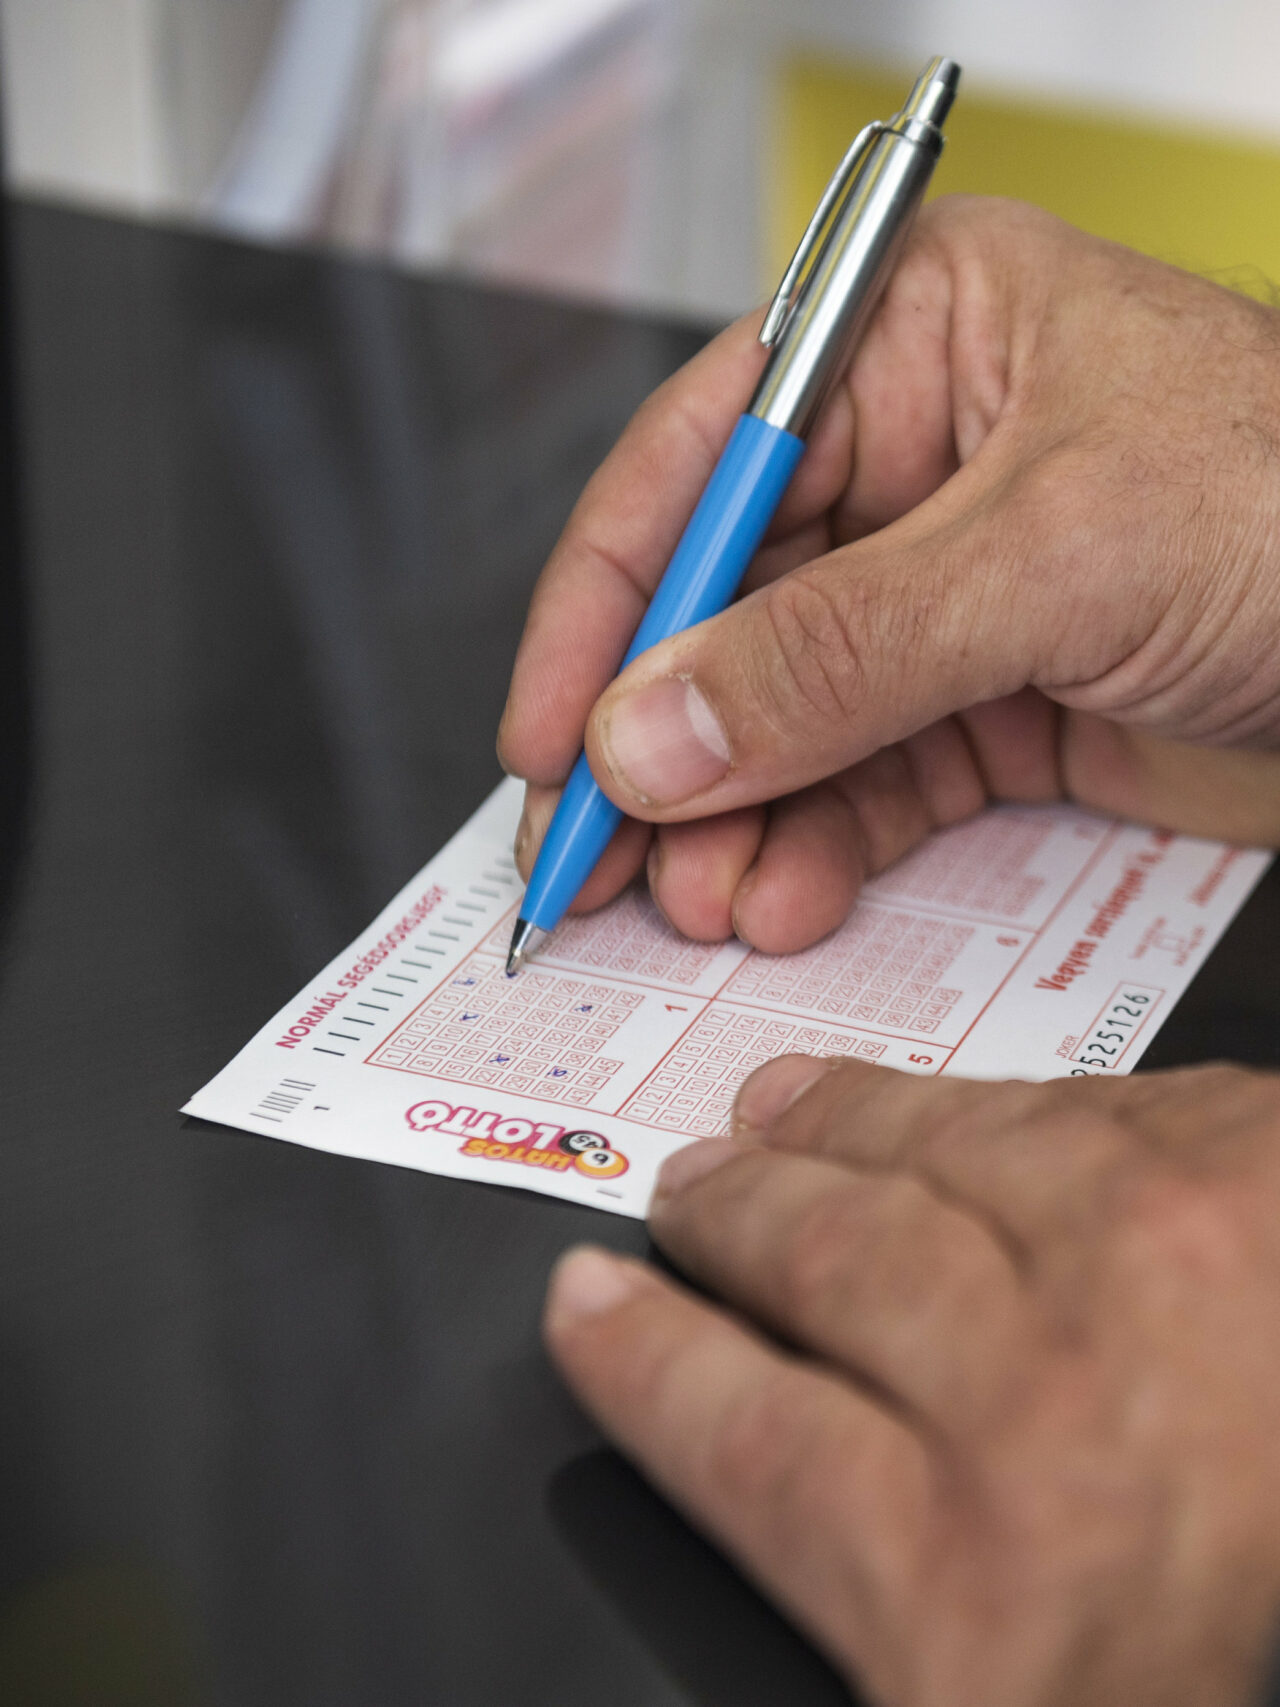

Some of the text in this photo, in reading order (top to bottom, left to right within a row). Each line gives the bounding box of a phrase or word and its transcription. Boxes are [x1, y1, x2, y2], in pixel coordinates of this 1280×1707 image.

[1034, 941, 1097, 991] Vegyen
[275, 991, 348, 1049] NORMÁL
[442, 1028, 463, 1038] 10
[472, 998, 491, 1008] 12
[665, 1004, 688, 1013] 1
[1071, 992, 1150, 1075] 2525126
[443, 1064, 464, 1075] 15
[458, 1049, 479, 1060] 16
[472, 1034, 493, 1044] 17
[487, 1019, 507, 1029] 18
[501, 1004, 520, 1014] 19
[474, 1070, 496, 1082] 22
[504, 1040, 523, 1051] 24
[517, 1025, 537, 1036] 25
[531, 1010, 551, 1021] 26
[545, 995, 564, 1006] 27
[506, 1077, 527, 1088] 29
[520, 1061, 540, 1073] 30
[534, 1047, 553, 1057] 31
[548, 1031, 568, 1042] 32
[561, 1016, 581, 1027] 33
[537, 1083, 558, 1094] 36
[565, 1053, 585, 1064] 38
[579, 1037, 598, 1048] 39
[593, 1022, 612, 1033] 40
[688, 1080, 708, 1091] 10
[701, 1065, 720, 1076] 11
[714, 1049, 733, 1060] 12
[725, 1034, 745, 1045] 13
[738, 1019, 757, 1029] 14
[799, 1031, 818, 1042] 28
[829, 1037, 849, 1048] 35
[860, 1043, 880, 1055] 42
[908, 1054, 933, 1066] 5
[1056, 1035, 1079, 1059] JOKER
[569, 1059, 616, 1101] 43 44 45
[693, 1119, 713, 1131] 15
[707, 1103, 726, 1114] 16
[744, 1055, 763, 1067] 19
[757, 1040, 776, 1051] 20
[768, 1024, 788, 1036] 21
[405, 1100, 604, 1151] 45 LOTTÓ
[460, 1138, 609, 1171] 6 HATOS
